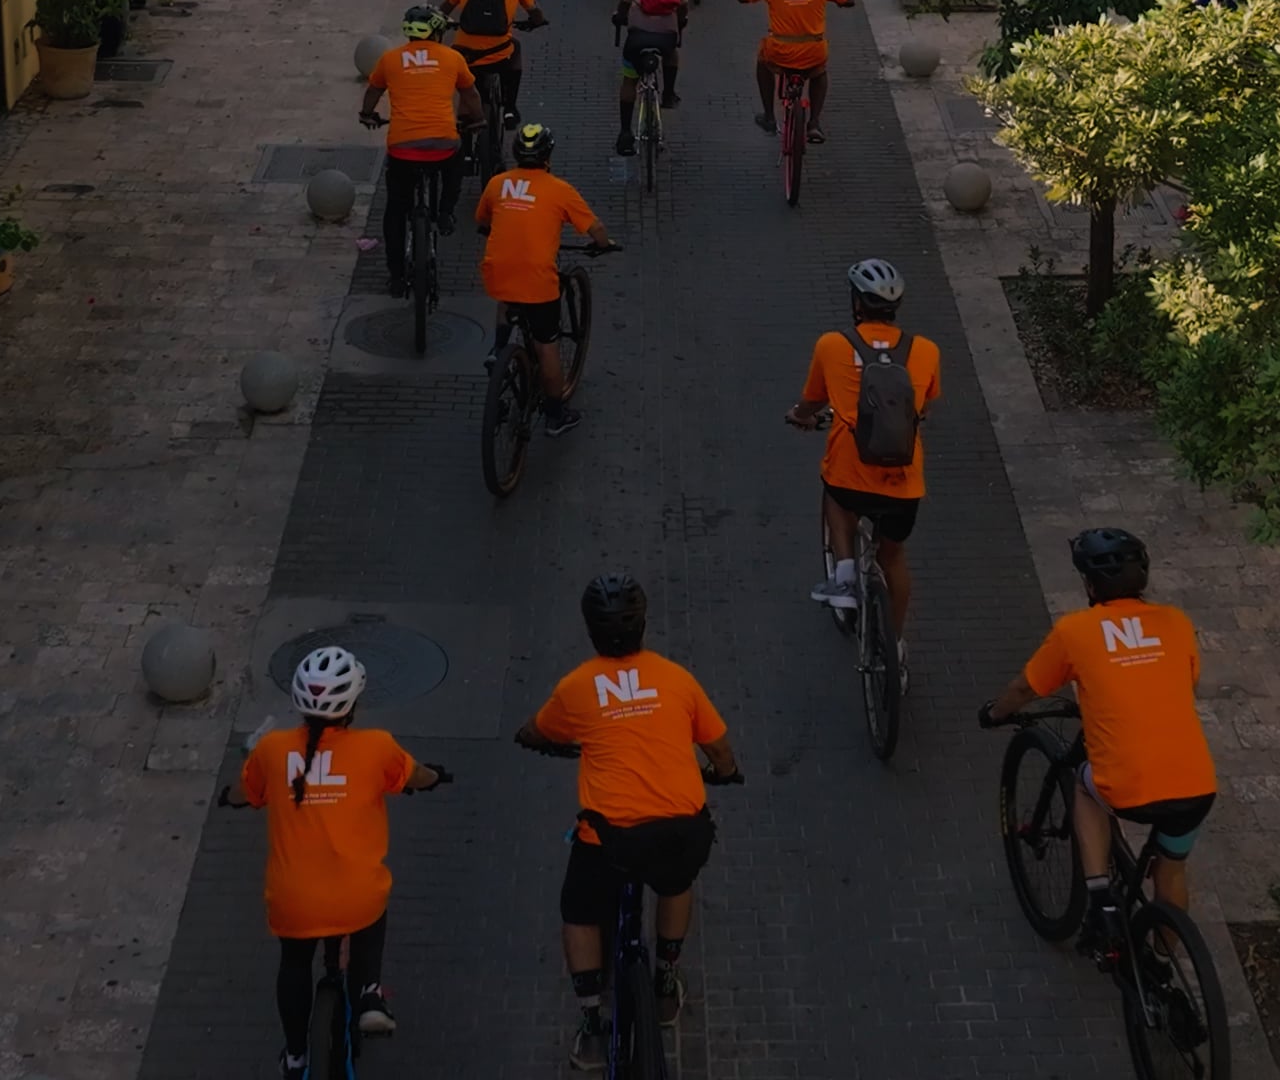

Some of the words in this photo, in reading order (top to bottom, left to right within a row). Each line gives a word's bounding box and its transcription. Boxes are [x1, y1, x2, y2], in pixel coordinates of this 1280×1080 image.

[402, 50, 439, 68] NL
[501, 178, 536, 202] NL
[1101, 616, 1162, 652] NL
[594, 668, 658, 708] NL
[287, 750, 347, 788] NL
